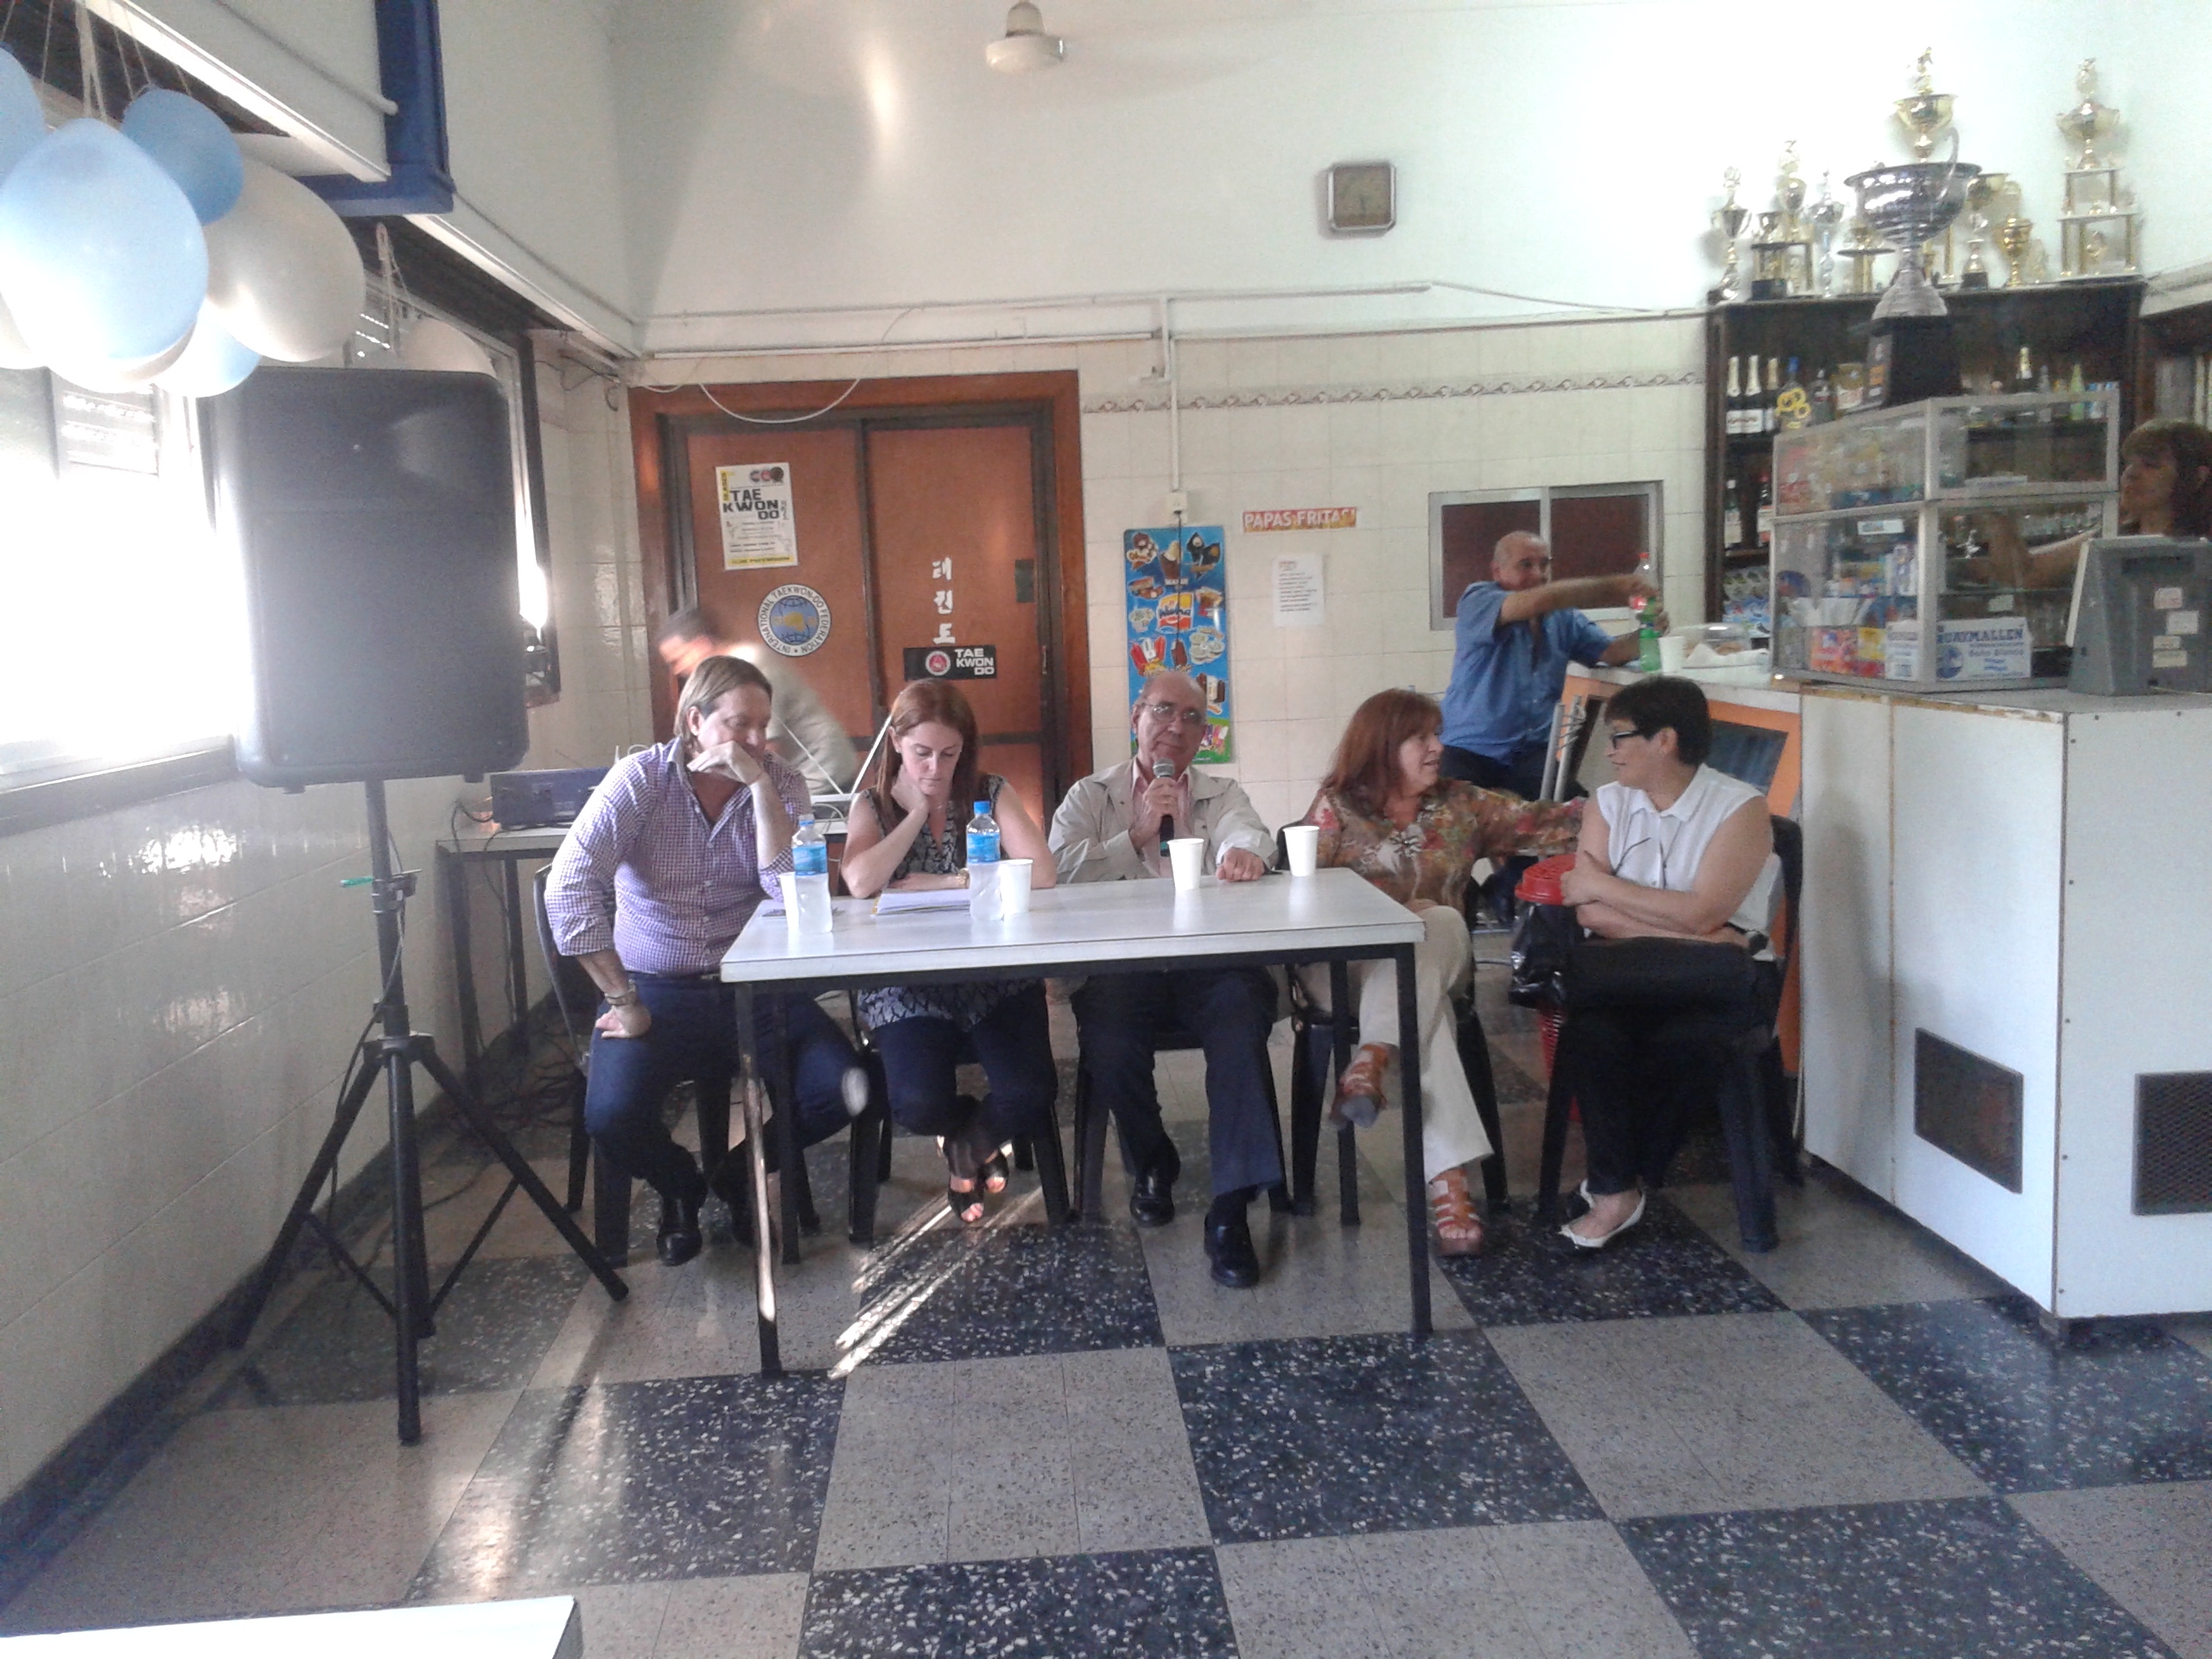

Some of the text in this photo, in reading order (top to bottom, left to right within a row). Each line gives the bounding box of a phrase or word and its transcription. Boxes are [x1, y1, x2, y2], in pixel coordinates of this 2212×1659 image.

[729, 488, 761, 502] TAE
[722, 499, 779, 513] KWON
[758, 510, 779, 520] DO
[1244, 511, 1293, 528] PAPAS
[760, 587, 829, 653] INTERNATIONAL TAEKWON-DO FEDERATION
[954, 648, 985, 658] TAE
[956, 657, 994, 668] KWON
[974, 666, 995, 676] DO
